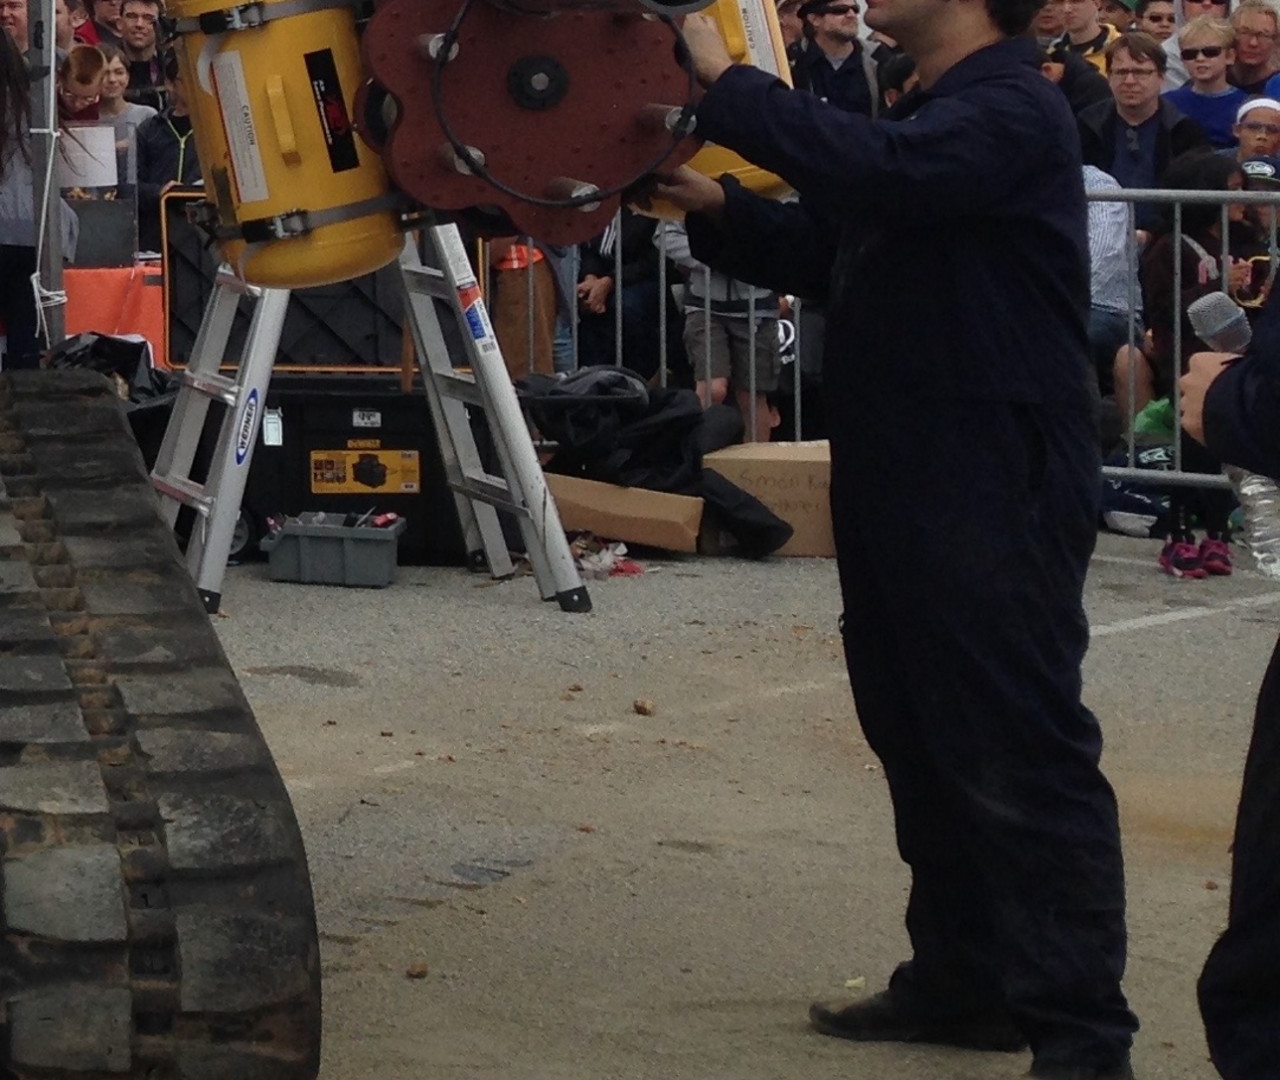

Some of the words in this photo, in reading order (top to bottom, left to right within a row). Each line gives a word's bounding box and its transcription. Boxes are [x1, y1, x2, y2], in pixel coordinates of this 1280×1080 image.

[742, 7, 756, 49] CAUTION
[242, 105, 256, 145] CAUTION
[240, 403, 255, 449] WERNER
